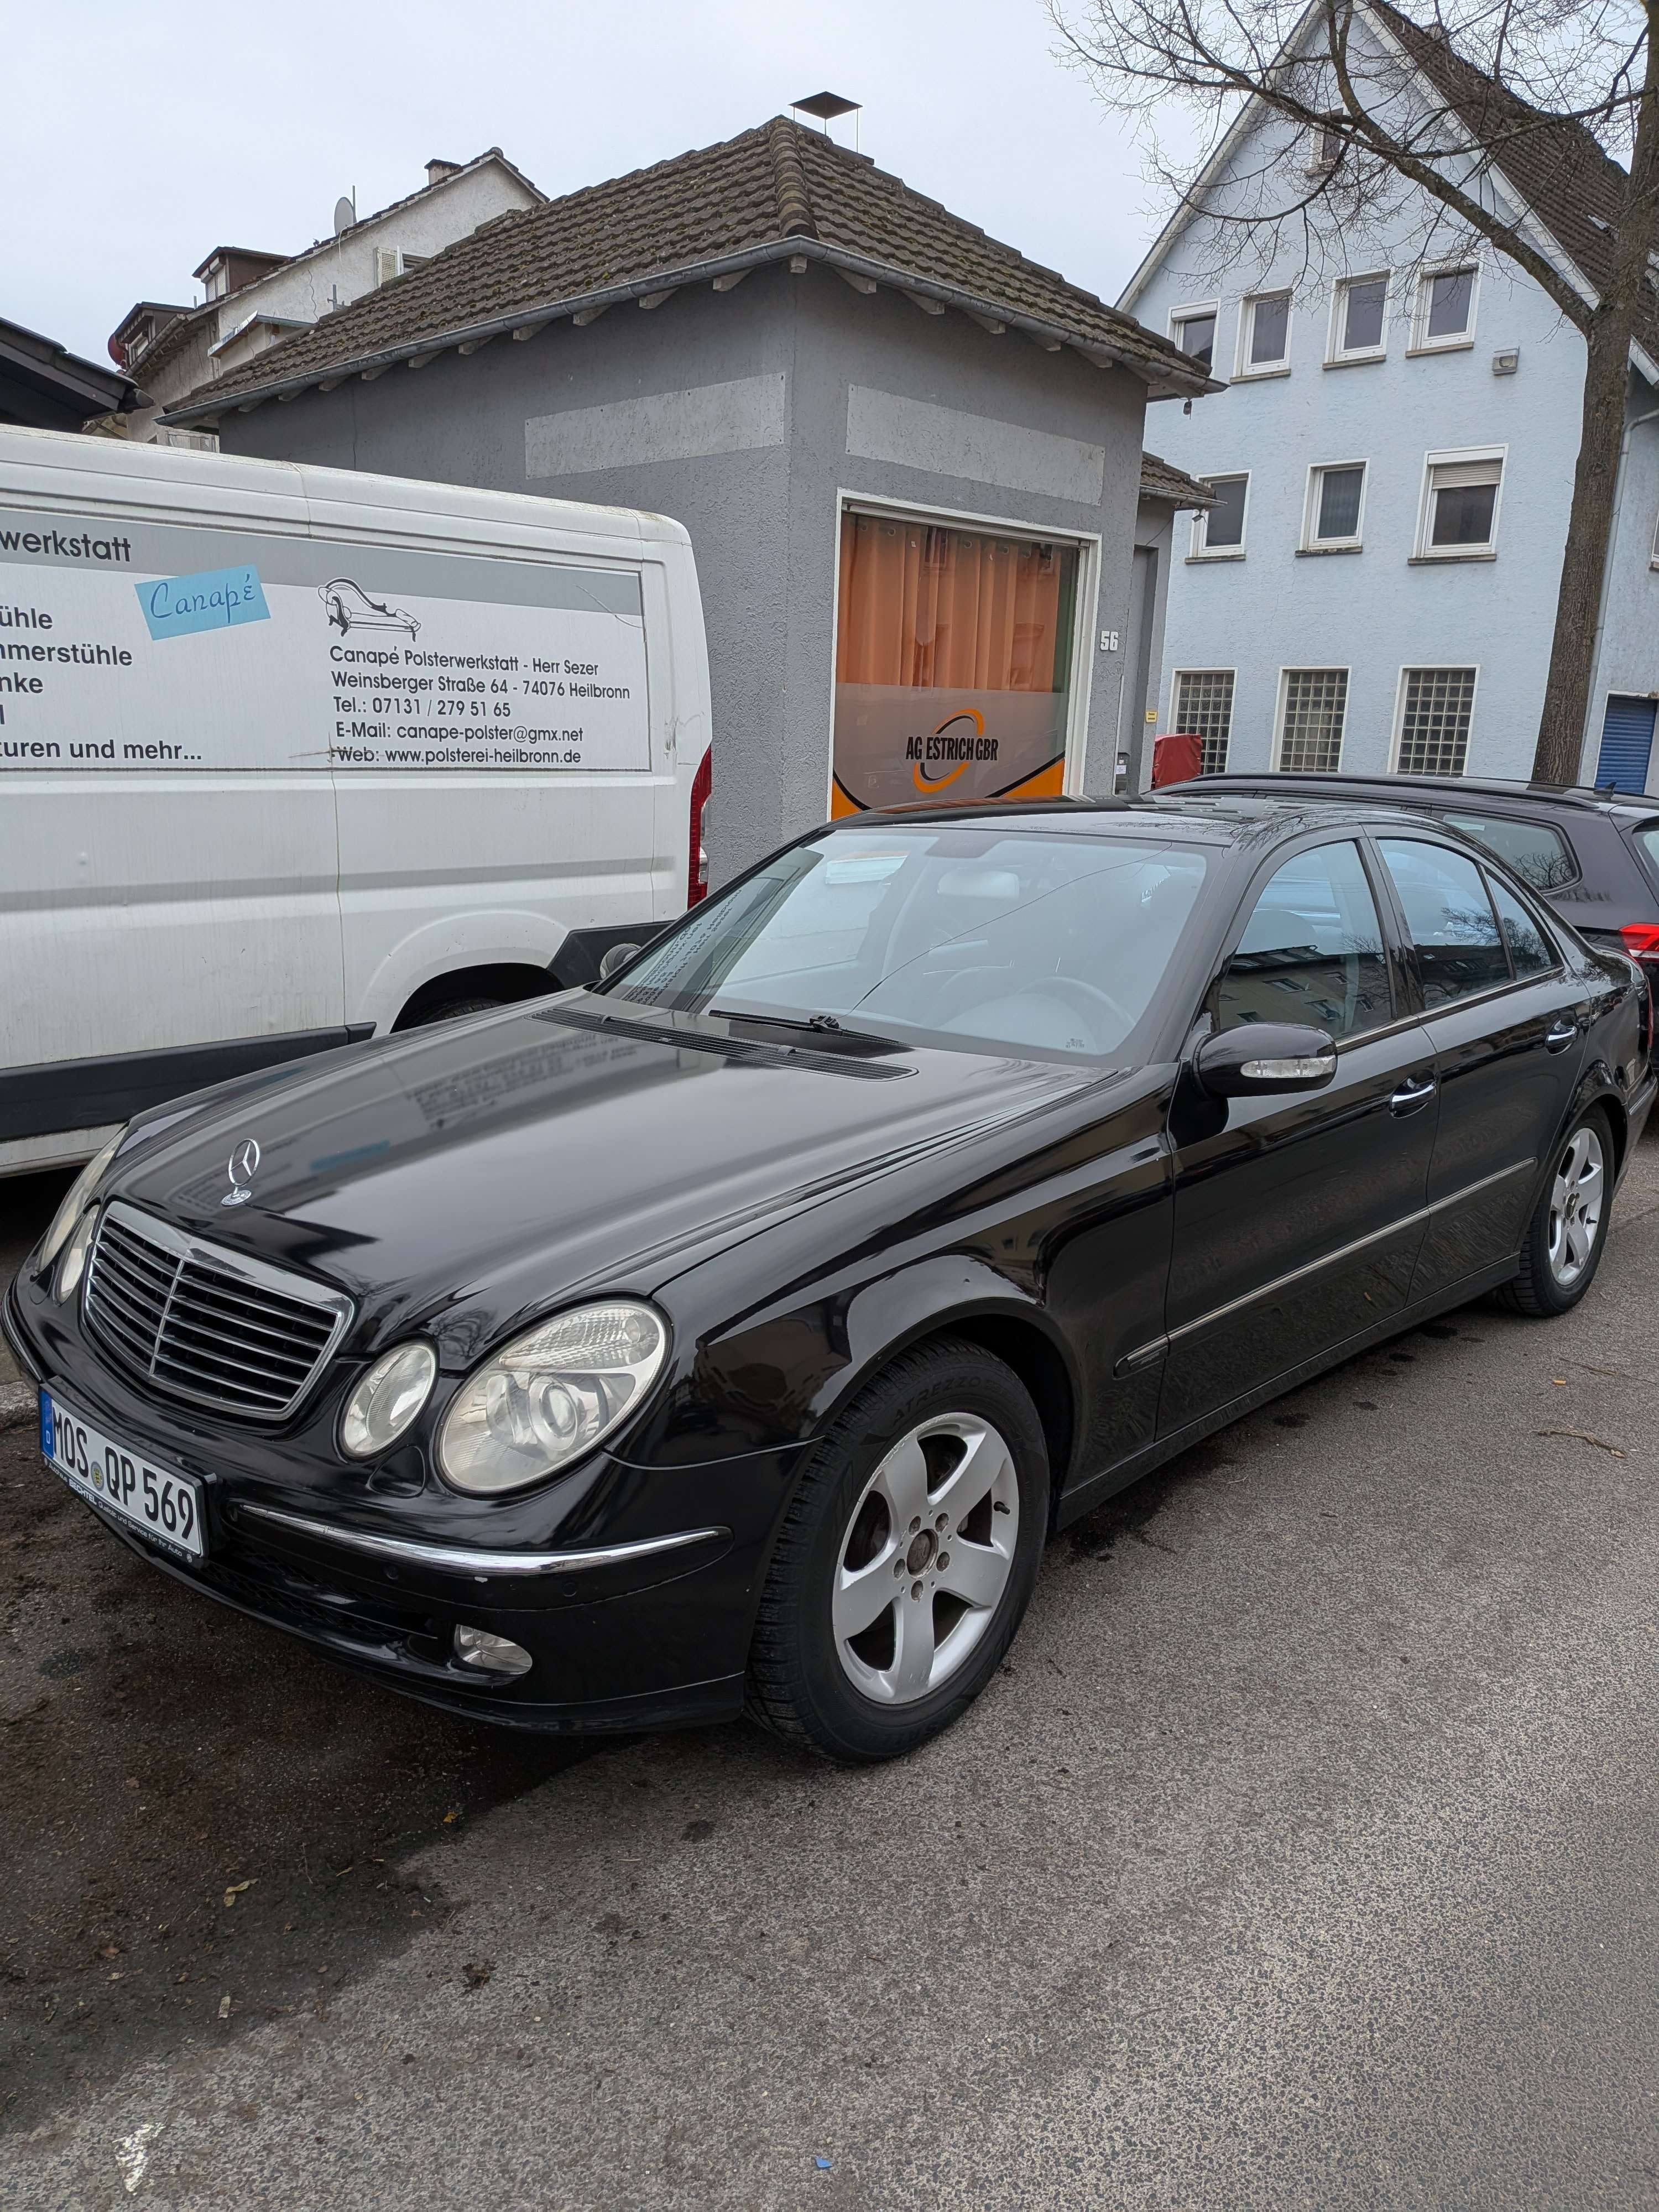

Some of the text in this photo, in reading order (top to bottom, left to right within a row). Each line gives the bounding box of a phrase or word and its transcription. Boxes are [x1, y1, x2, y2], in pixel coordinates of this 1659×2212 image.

[0, 530, 131, 562] werkstatt
[150, 573, 257, 623] Canapé
[0, 606, 52, 629] ühle
[1100, 631, 1118, 651] 56
[330, 646, 399, 667] Canapé
[405, 650, 518, 671] Polsterwerkstatt
[533, 658, 560, 673] Herr
[564, 661, 598, 676] Sezer
[331, 671, 434, 694] Weinsberger
[439, 676, 485, 692] Straße
[491, 679, 508, 693] 64
[523, 681, 565, 696] 74076
[570, 684, 630, 699] Heilbronn
[333, 696, 510, 717] Tel.: 07131 / 279 51 65
[336, 722, 583, 743] E-Mail: canape-polster@gmx.net
[0, 739, 201, 759] uren und mehr...
[336, 746, 581, 765] Web: www.polsterei-heilbronn.de
[906, 737, 998, 761] AG ESTRICH GBR
[46, 1430, 50, 1444] D
[53, 1406, 194, 1540] MOS QP 569
[69, 1478, 97, 1505] BECHTEL
[168, 1544, 182, 1557] Auto
